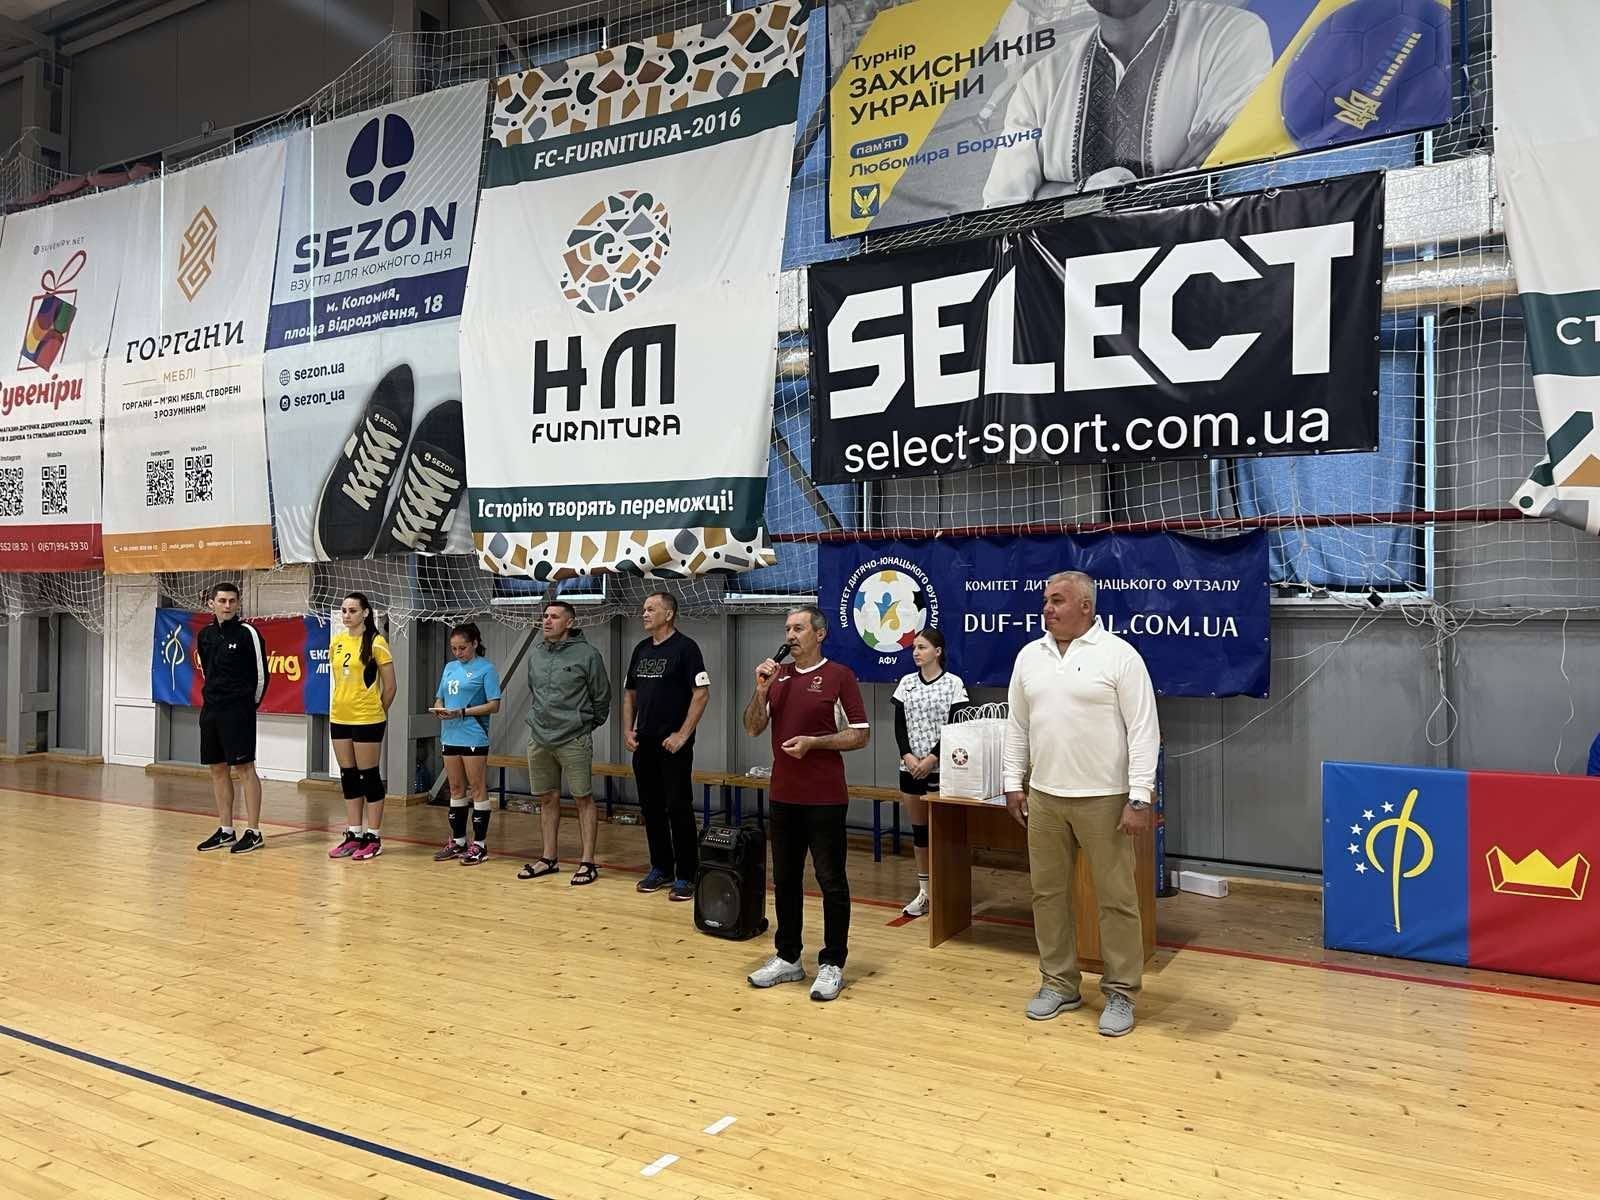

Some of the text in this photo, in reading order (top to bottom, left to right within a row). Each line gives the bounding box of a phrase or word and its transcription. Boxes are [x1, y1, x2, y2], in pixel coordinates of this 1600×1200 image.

[850, 28, 1056, 99] ЗАХИСНИКІВ
[852, 44, 916, 72] Турнір
[850, 74, 984, 125] УКРАЇНИ
[534, 107, 741, 170] FC-FURNITURA-2016
[850, 127, 1043, 178] Любомира Бордуна
[293, 201, 458, 274] SEZON
[333, 267, 358, 285] ДЛЯ
[361, 254, 420, 276] КОЖНОГО
[423, 247, 452, 265] ДНЯ
[326, 287, 400, 314] м. Коломия,
[327, 305, 418, 334] Відродження,
[424, 294, 443, 314] 18
[828, 221, 1354, 420] SELECT
[163, 368, 196, 383] МЕБЛІ
[294, 362, 345, 381] sezon.ua
[122, 399, 152, 411] ГОРГАНИ
[160, 394, 180, 405] М'ЯКІ
[205, 385, 241, 399] СТВОРЕНІ
[160, 404, 206, 418] РОЗУМІННЯМ
[294, 389, 345, 408] sezon_ua
[532, 414, 681, 444] FURNITURA
[844, 406, 1330, 475] select-sport.com.ua
[431, 457, 455, 474] SEZON
[478, 489, 735, 522] Історію творять переможці!
[840, 556, 939, 630] КОМІТЕТ ДИТЯЧО-ЮНАЦЬКОГО ФУТЗАЛУ
[965, 578, 1240, 592] КОМІТЕТ ДИТНАЦЬКОГО ФУТЗАЛУ
[964, 612, 1239, 638] DUF-FAL.COM.UA
[343, 653, 352, 668] 2
[878, 656, 898, 665] АФУ
[447, 679, 459, 695] 13
